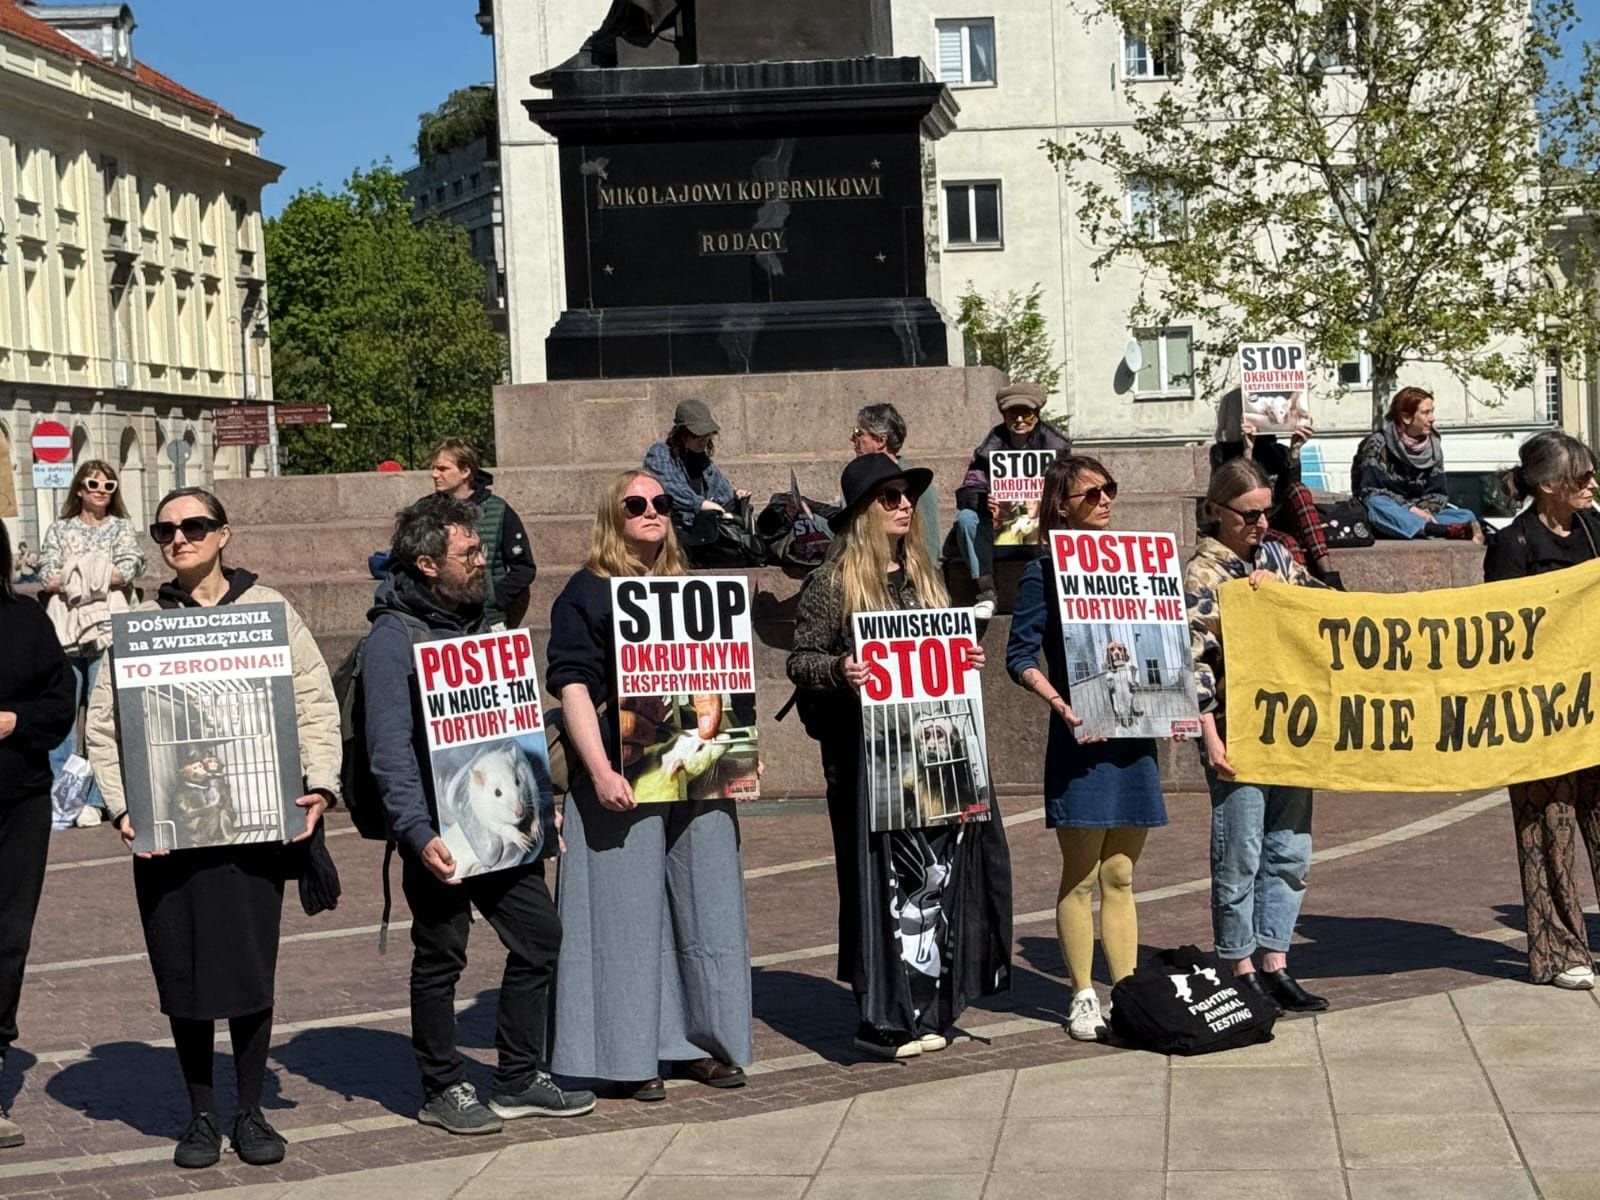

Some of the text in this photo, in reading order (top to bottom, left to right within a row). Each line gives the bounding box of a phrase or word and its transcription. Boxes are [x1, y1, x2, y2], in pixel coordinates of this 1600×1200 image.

[600, 176, 882, 206] MIKOŁAJOWI KOPERNIKOWI
[702, 231, 785, 252] RODACY
[1242, 346, 1302, 371] STOP
[1244, 371, 1304, 383] OKRUTNYM
[993, 478, 1045, 490] OKRUTNY
[1054, 534, 1175, 577] POSTĘP
[1060, 575, 1079, 595] W
[127, 610, 271, 633] DOŚWIADCZENIA
[616, 580, 746, 642] STOP
[858, 612, 972, 639] WIWISEKCJA
[1318, 606, 1547, 671] TORTURY
[129, 629, 274, 651] na ZWIERZĘTACH
[123, 653, 285, 679] TO ZBRODNIA!!
[421, 633, 531, 691] POSTĘP
[620, 642, 750, 673] OKRUTNYM
[861, 638, 975, 701] STOP
[622, 671, 752, 693] EKSPERYMENTOM
[427, 692, 445, 718] W
[1255, 672, 1594, 752] TO NIE NAUKA
[1188, 987, 1238, 1016] FIGHTING
[1204, 998, 1245, 1023] ANIMAL
[1208, 1008, 1253, 1033] TESTING
